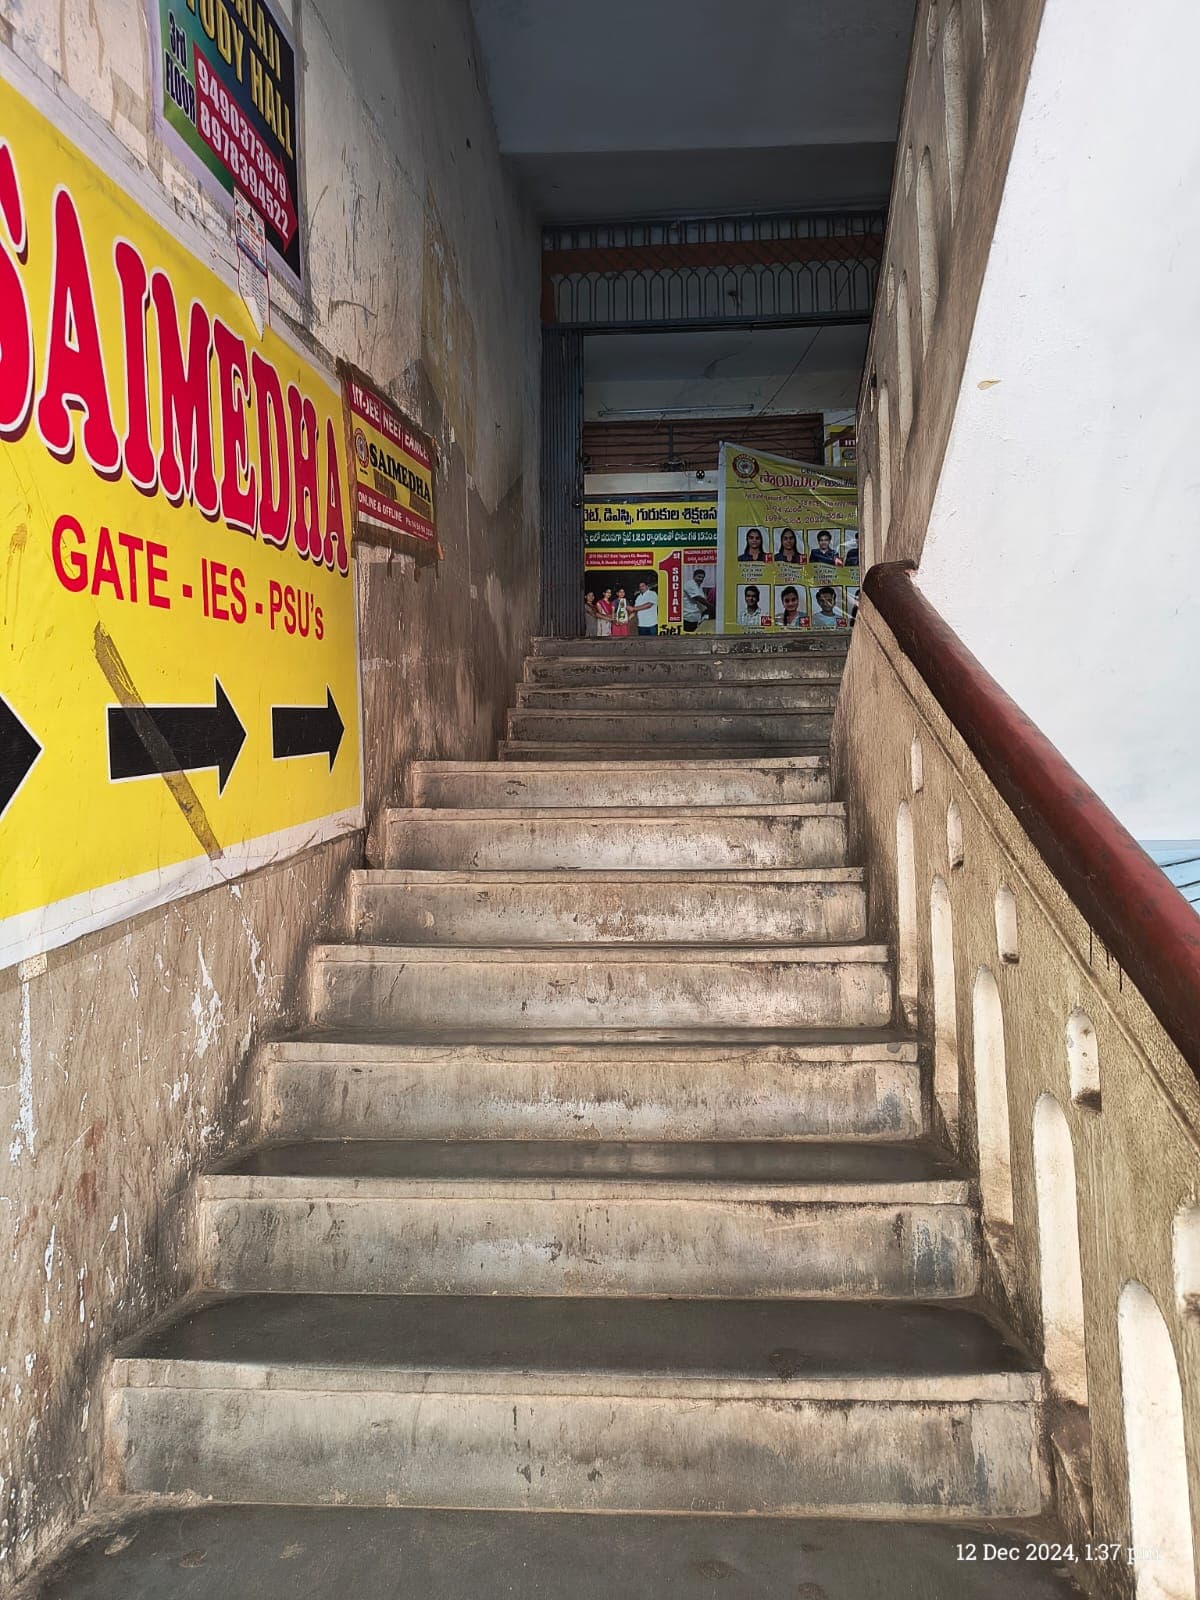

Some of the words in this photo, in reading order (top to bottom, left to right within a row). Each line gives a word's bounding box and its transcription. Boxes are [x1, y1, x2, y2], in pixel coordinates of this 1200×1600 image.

[168, 9, 187, 72] 3rd
[187, 0, 244, 85] UDY
[249, 48, 293, 160] HALL
[230, 0, 281, 83] LAJI
[164, 48, 196, 128] FLOOR
[197, 58, 287, 203] 9490373879
[200, 101, 289, 239] 8978394522
[352, 383, 380, 423] IIT-JEE
[404, 432, 430, 463] EAMC
[369, 443, 431, 503] SAIMEDHA
[51, 514, 171, 610] GATE
[201, 557, 247, 624] IES
[269, 580, 324, 641] PSU's
[671, 567, 680, 614] SOCIAL
